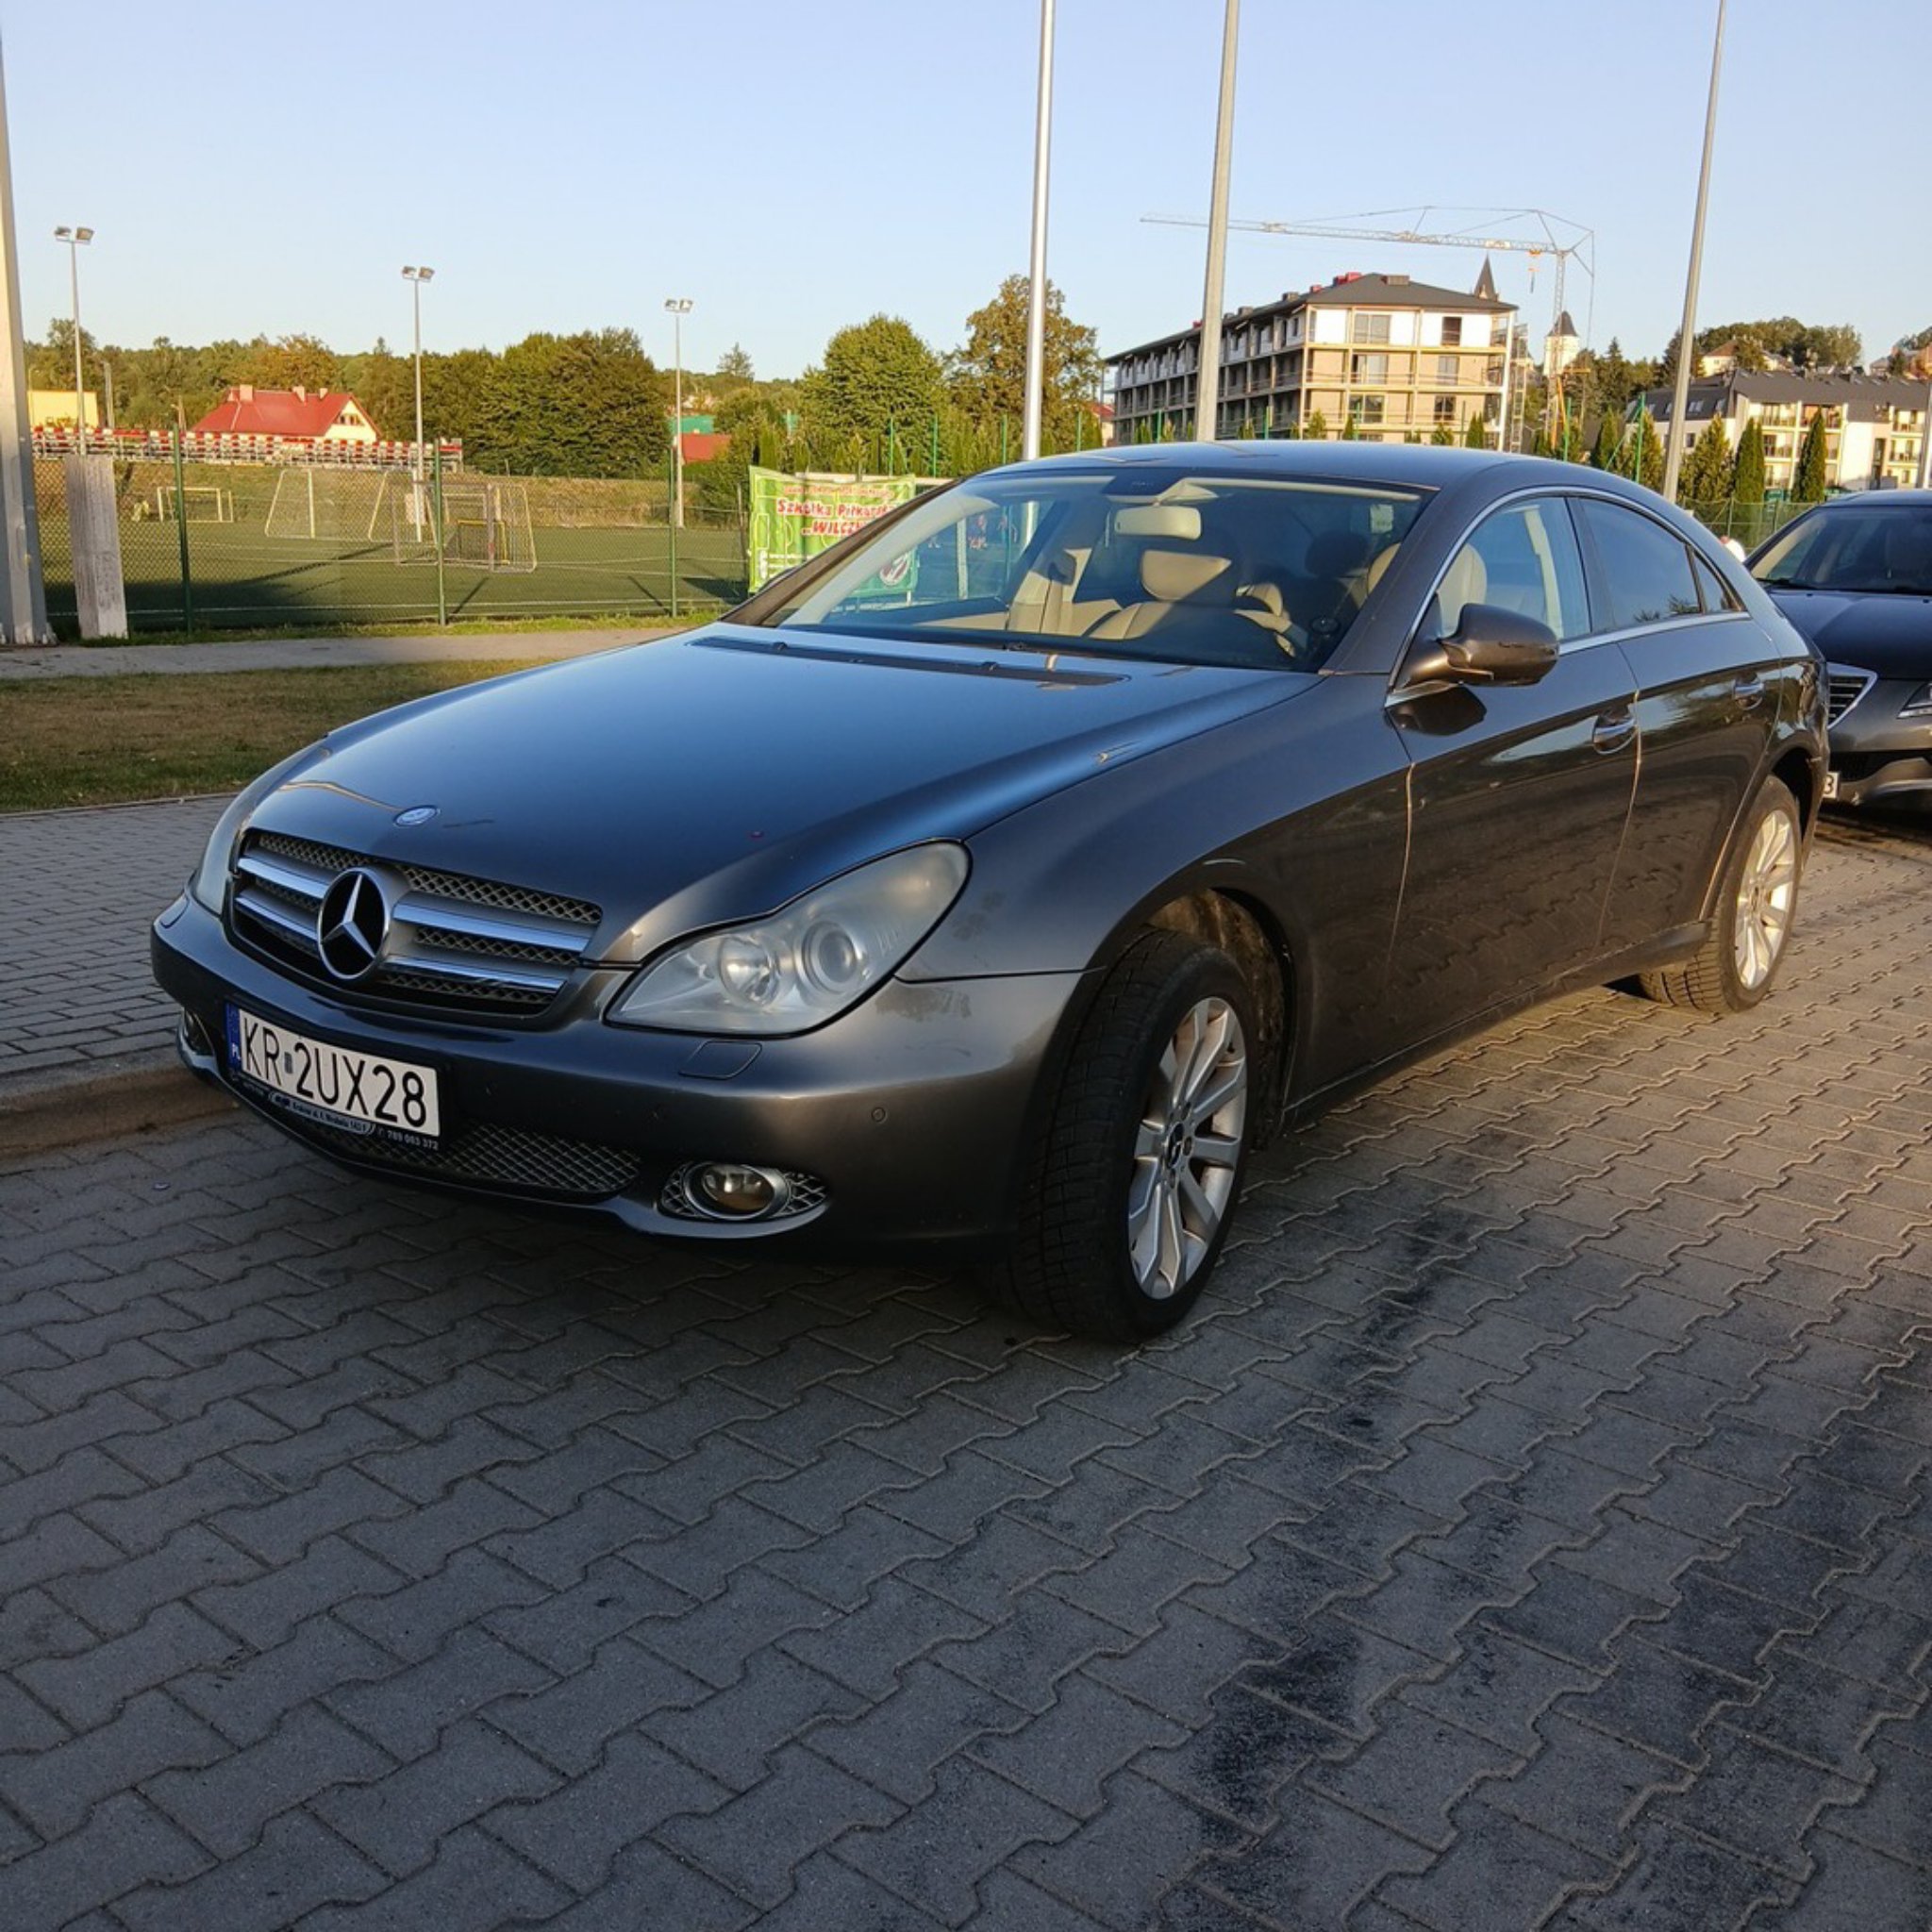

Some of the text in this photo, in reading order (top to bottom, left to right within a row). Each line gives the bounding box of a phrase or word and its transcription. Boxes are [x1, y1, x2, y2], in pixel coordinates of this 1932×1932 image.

[838, 503, 895, 516] Piłkarsk
[243, 1017, 281, 1086] KR
[293, 1041, 427, 1128] 2UX28
